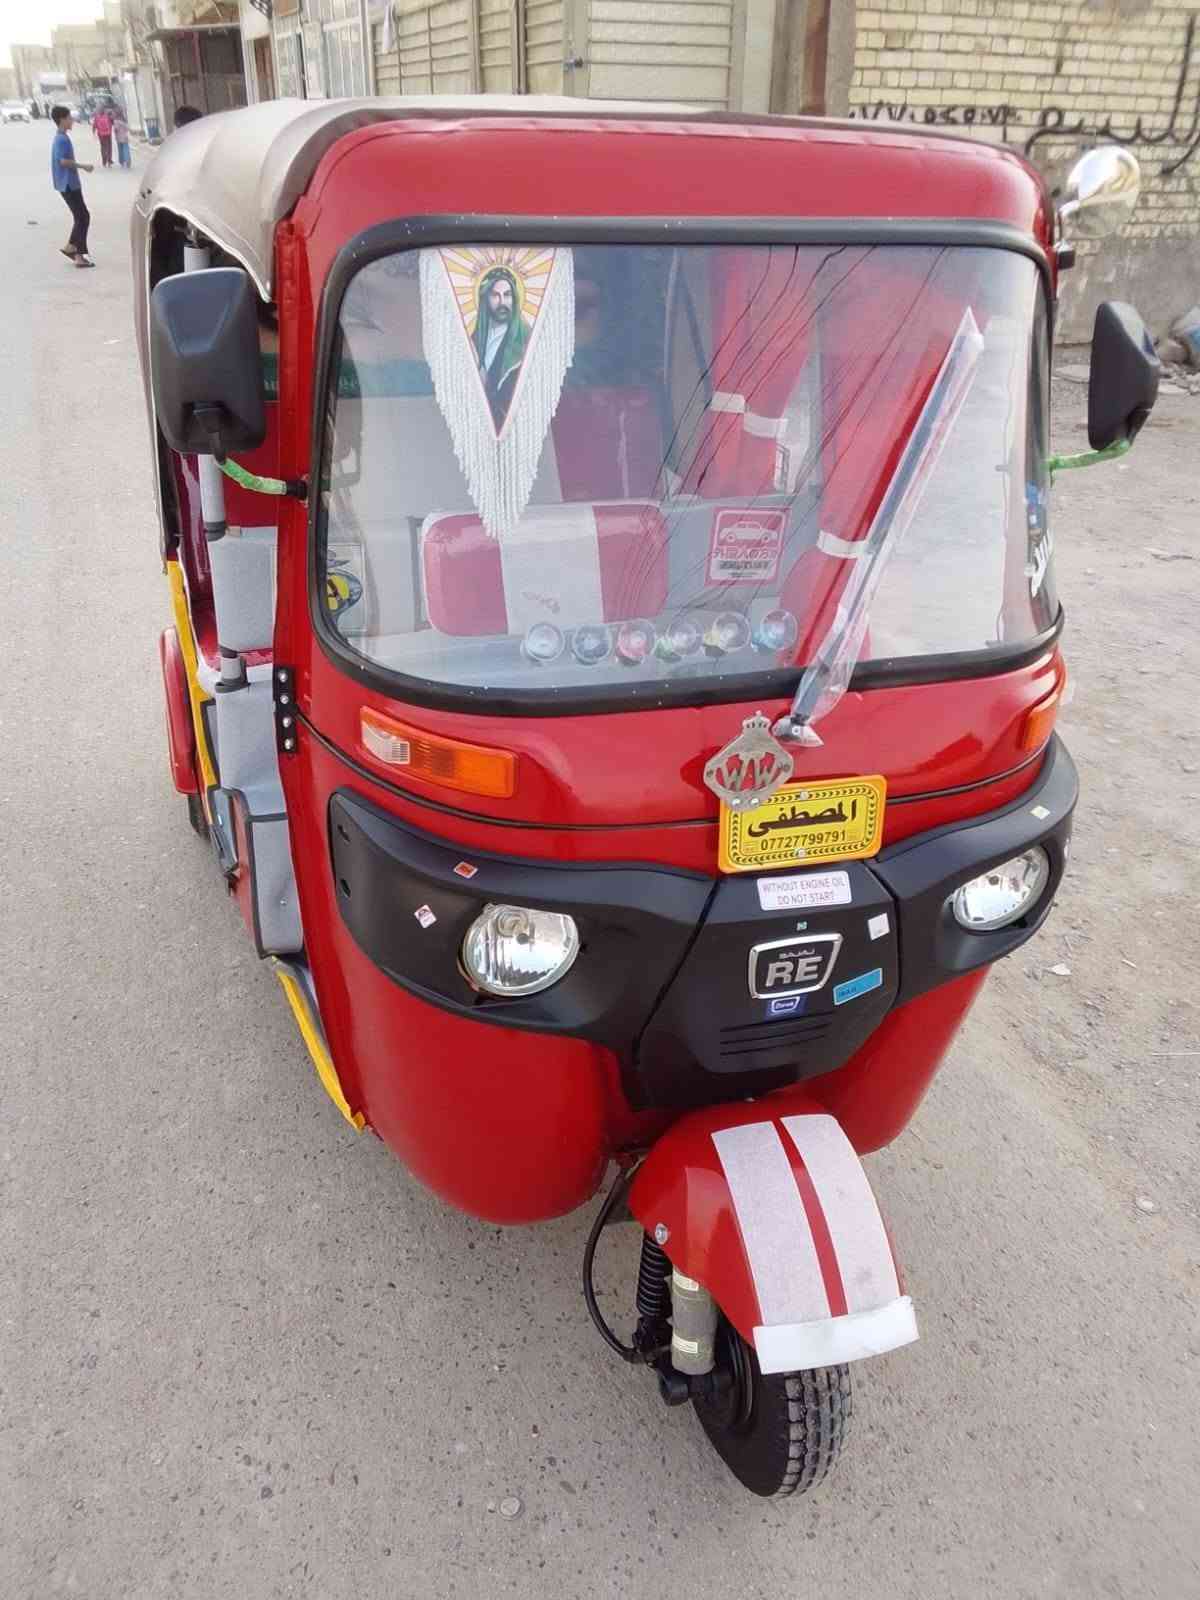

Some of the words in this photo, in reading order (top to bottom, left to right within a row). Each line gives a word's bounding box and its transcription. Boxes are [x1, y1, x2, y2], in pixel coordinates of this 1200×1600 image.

[748, 799, 857, 837] المصطفى
[760, 830, 847, 851] 07727799791
[763, 878, 798, 893] WITHOUT
[800, 876, 831, 890] ENGINE
[832, 875, 846, 887] OIL
[777, 894, 789, 905] DO
[790, 893, 807, 904] NOT
[809, 890, 835, 903] START
[765, 955, 824, 987] RE
